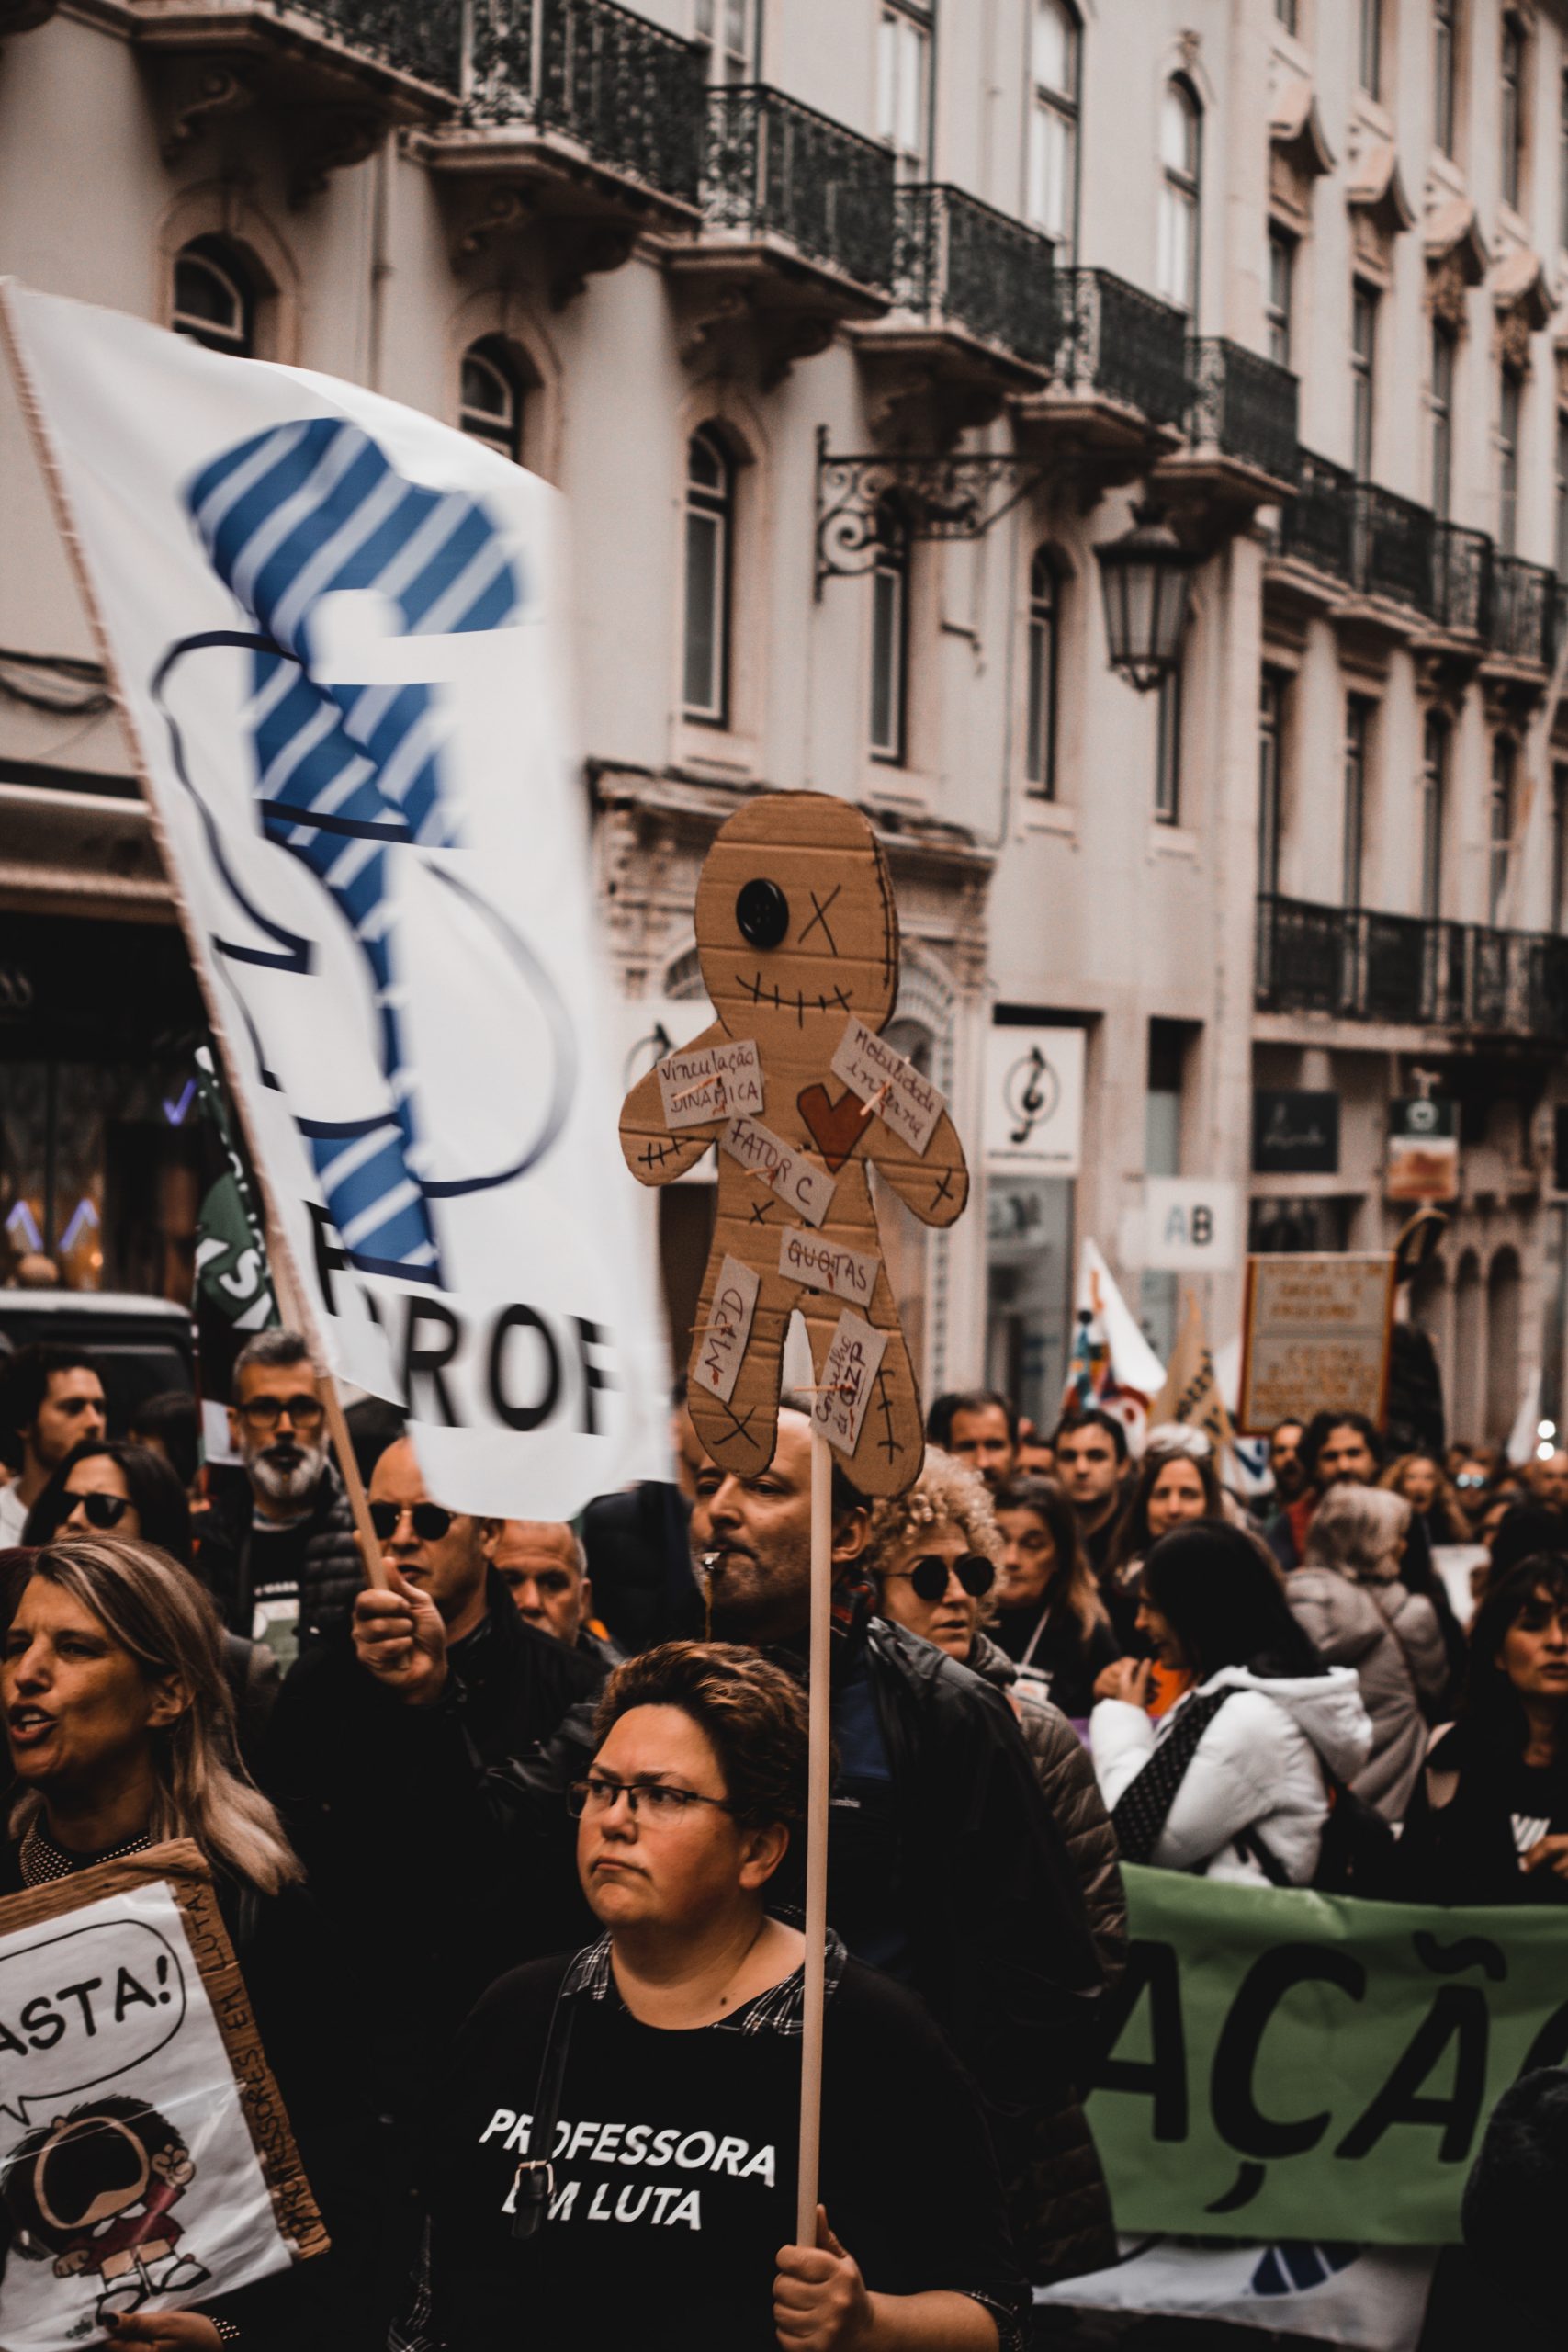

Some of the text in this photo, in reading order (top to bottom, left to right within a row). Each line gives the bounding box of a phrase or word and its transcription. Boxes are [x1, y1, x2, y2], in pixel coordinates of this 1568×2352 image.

[661, 1046, 754, 1081] Vinculação
[731, 1118, 813, 1205] FATOR C
[1088, 1931, 1568, 2213] AÇÃ
[587, 2183, 701, 2231] LUTA
